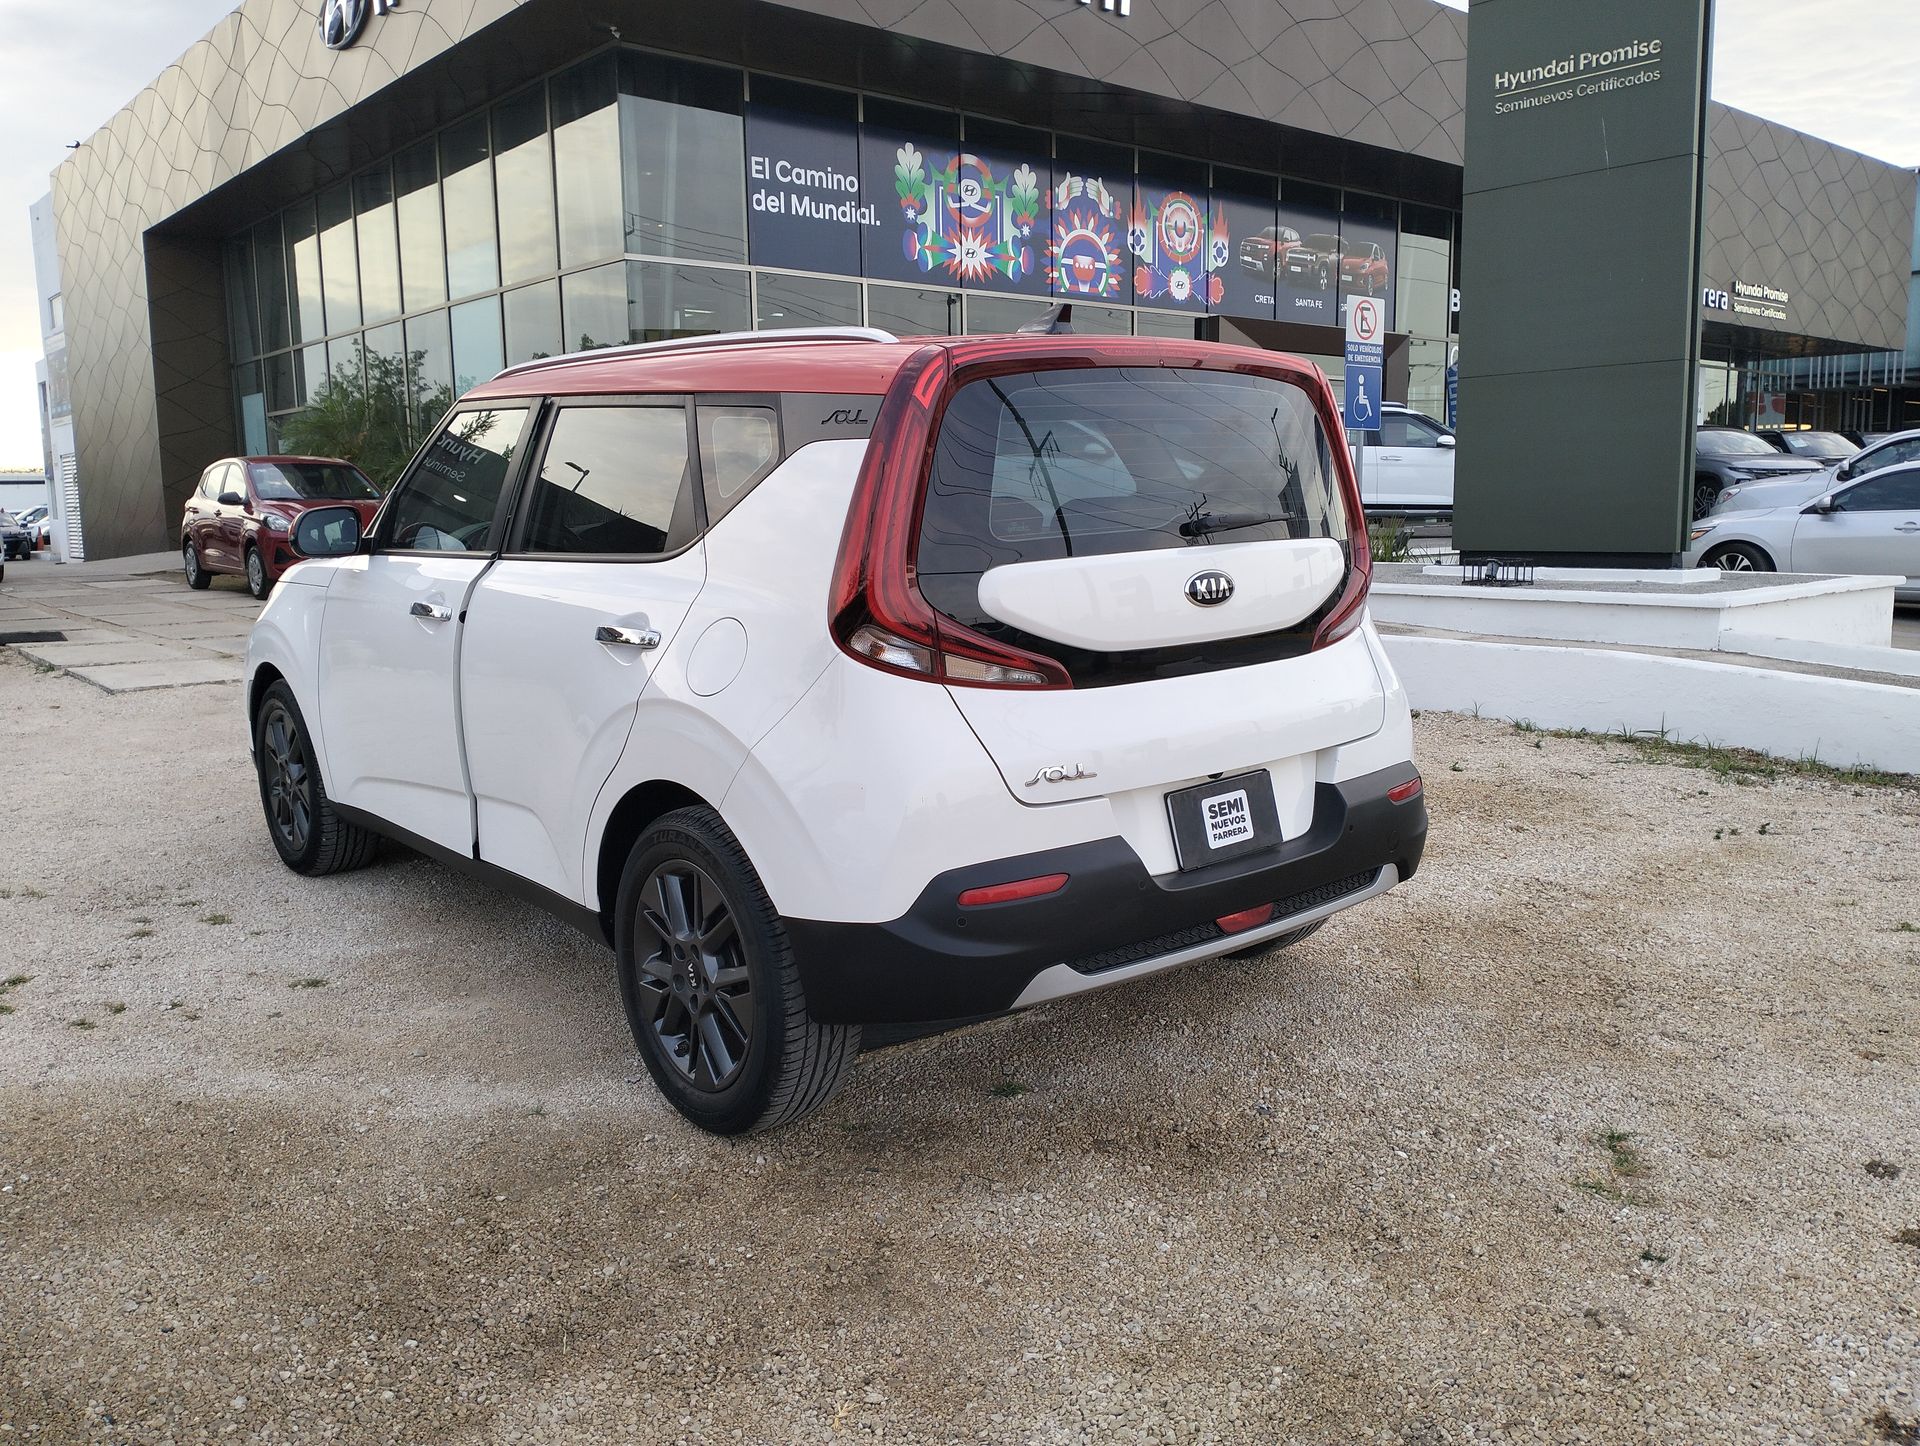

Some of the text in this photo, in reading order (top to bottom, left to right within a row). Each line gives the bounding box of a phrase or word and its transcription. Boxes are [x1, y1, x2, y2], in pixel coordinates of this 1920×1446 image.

[1495, 39, 1662, 90] Hyundai Promise
[1495, 69, 1661, 115] Seminuevos Certificados
[751, 155, 859, 193] El Camino
[752, 189, 881, 226] del Mundial.
[1254, 294, 1275, 305] CRETA
[1735, 280, 1789, 303] Hyundai Promise
[1295, 298, 1323, 309] SANTA FE
[1733, 302, 1787, 320] Seminuevos Certificados
[1347, 343, 1359, 352] SOLO
[1347, 353, 1354, 362] DE
[1194, 577, 1230, 600] KIA
[1208, 796, 1245, 820] SEMI
[1211, 814, 1247, 831] NUEVOS
[1213, 825, 1248, 842] FARRERA
